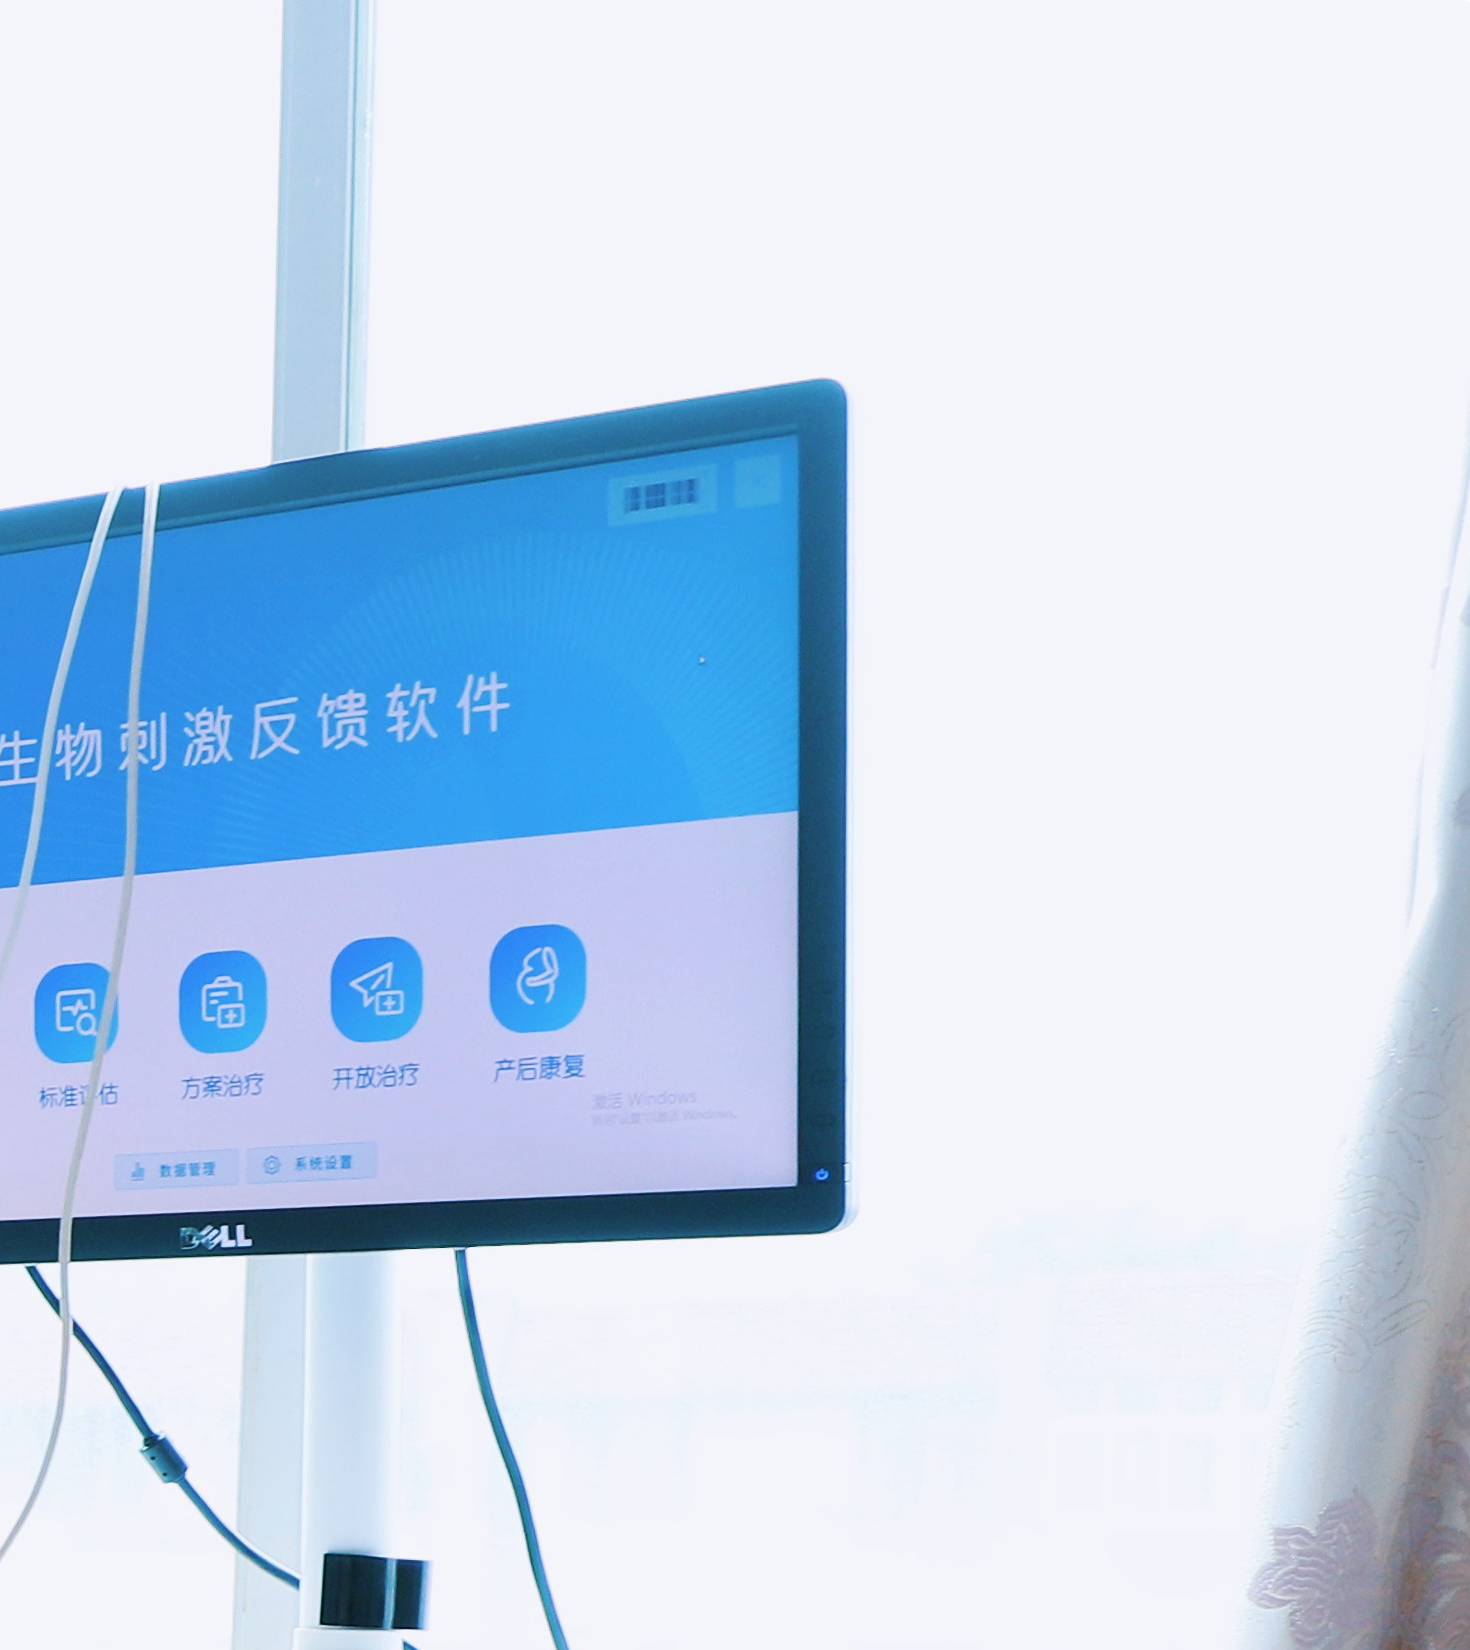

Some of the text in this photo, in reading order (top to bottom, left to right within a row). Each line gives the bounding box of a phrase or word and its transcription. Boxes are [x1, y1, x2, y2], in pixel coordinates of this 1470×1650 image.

[332, 1062, 421, 1090] 开放治疗
[493, 1054, 587, 1083] 产后康复
[181, 1072, 265, 1101] 方案治疗
[180, 1224, 253, 1250] DELL
